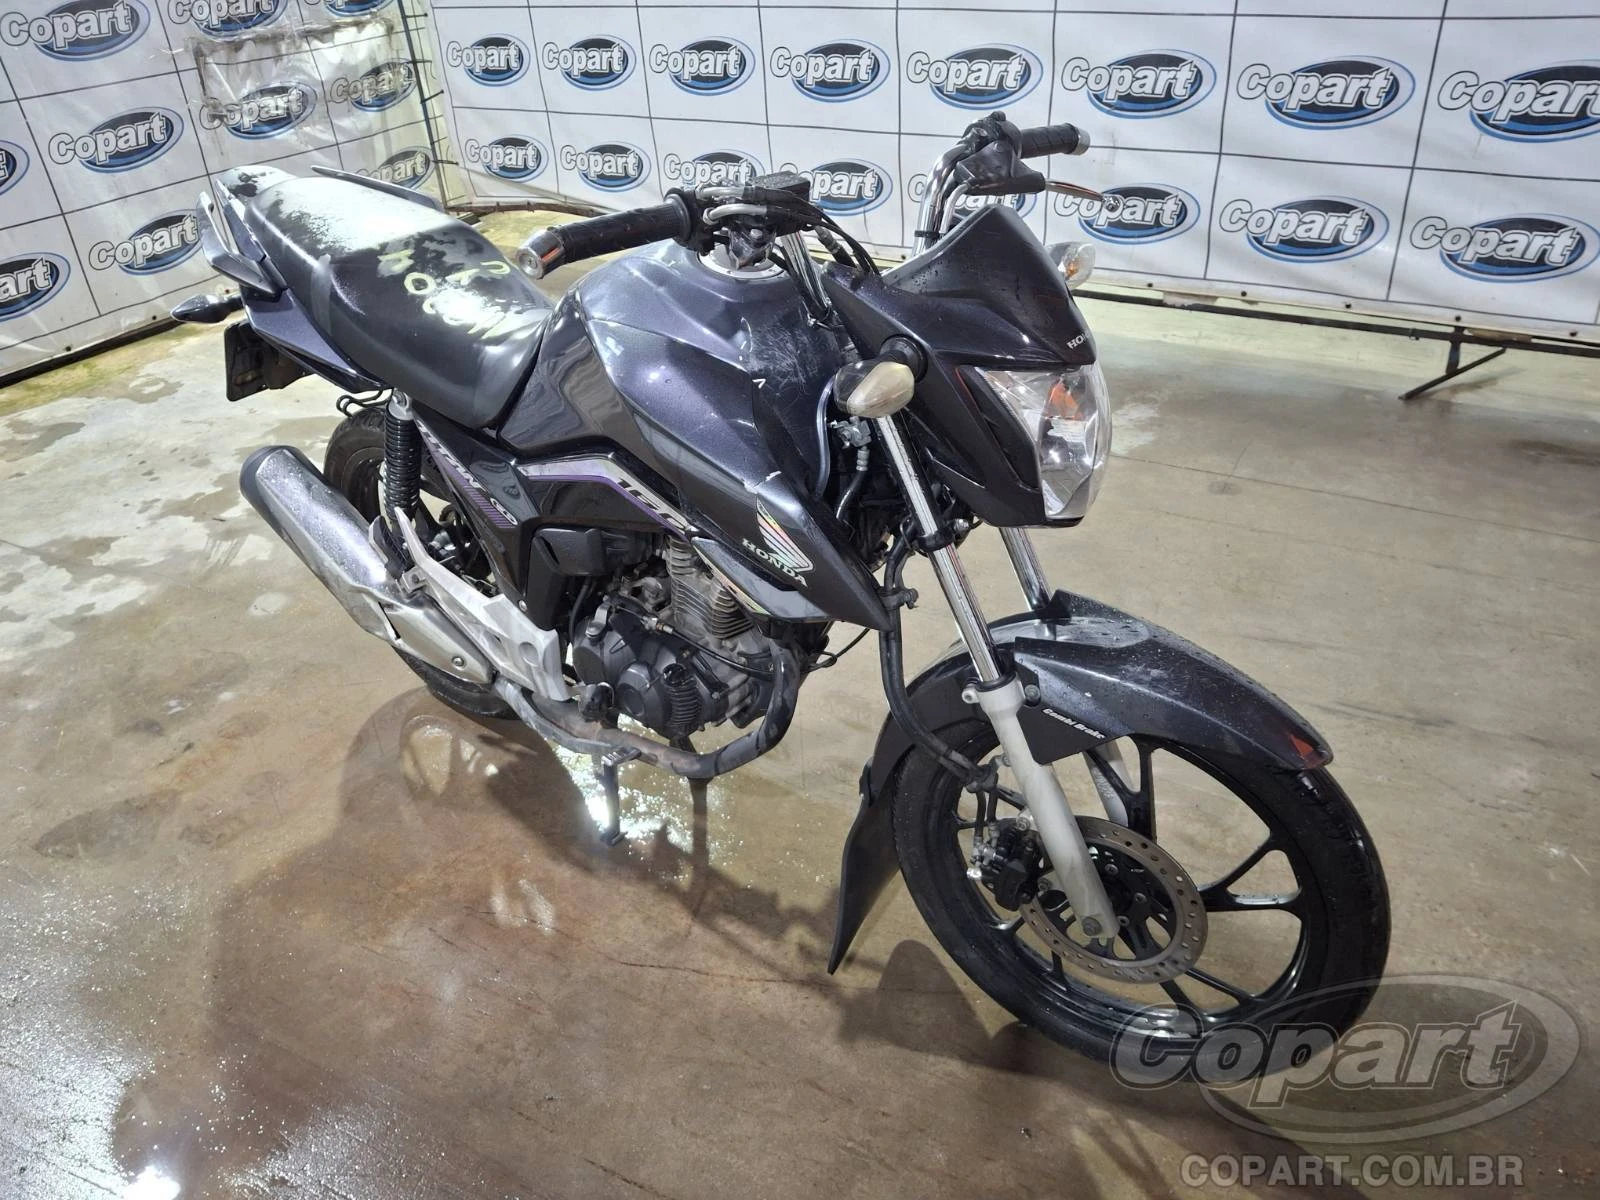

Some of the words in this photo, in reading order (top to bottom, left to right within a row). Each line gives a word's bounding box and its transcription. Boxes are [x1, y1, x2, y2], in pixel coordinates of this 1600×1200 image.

[0, 3, 134, 50] Copart
[447, 41, 519, 72] Copart
[542, 41, 625, 76] Copart
[649, 44, 741, 81] Copart
[770, 47, 874, 86] Copart
[906, 51, 1026, 93] Copart
[1061, 57, 1200, 102] Copart
[1236, 63, 1394, 112] Copart
[1437, 70, 1600, 123] Copar
[48, 111, 167, 165] Copart
[465, 139, 539, 173] Copart
[560, 144, 640, 181] Copart
[664, 153, 752, 185] Copart
[89, 213, 199, 271] Copart
[1219, 199, 1370, 245] Copart
[1410, 216, 1580, 265] Copart
[742, 538, 809, 588] HONDA
